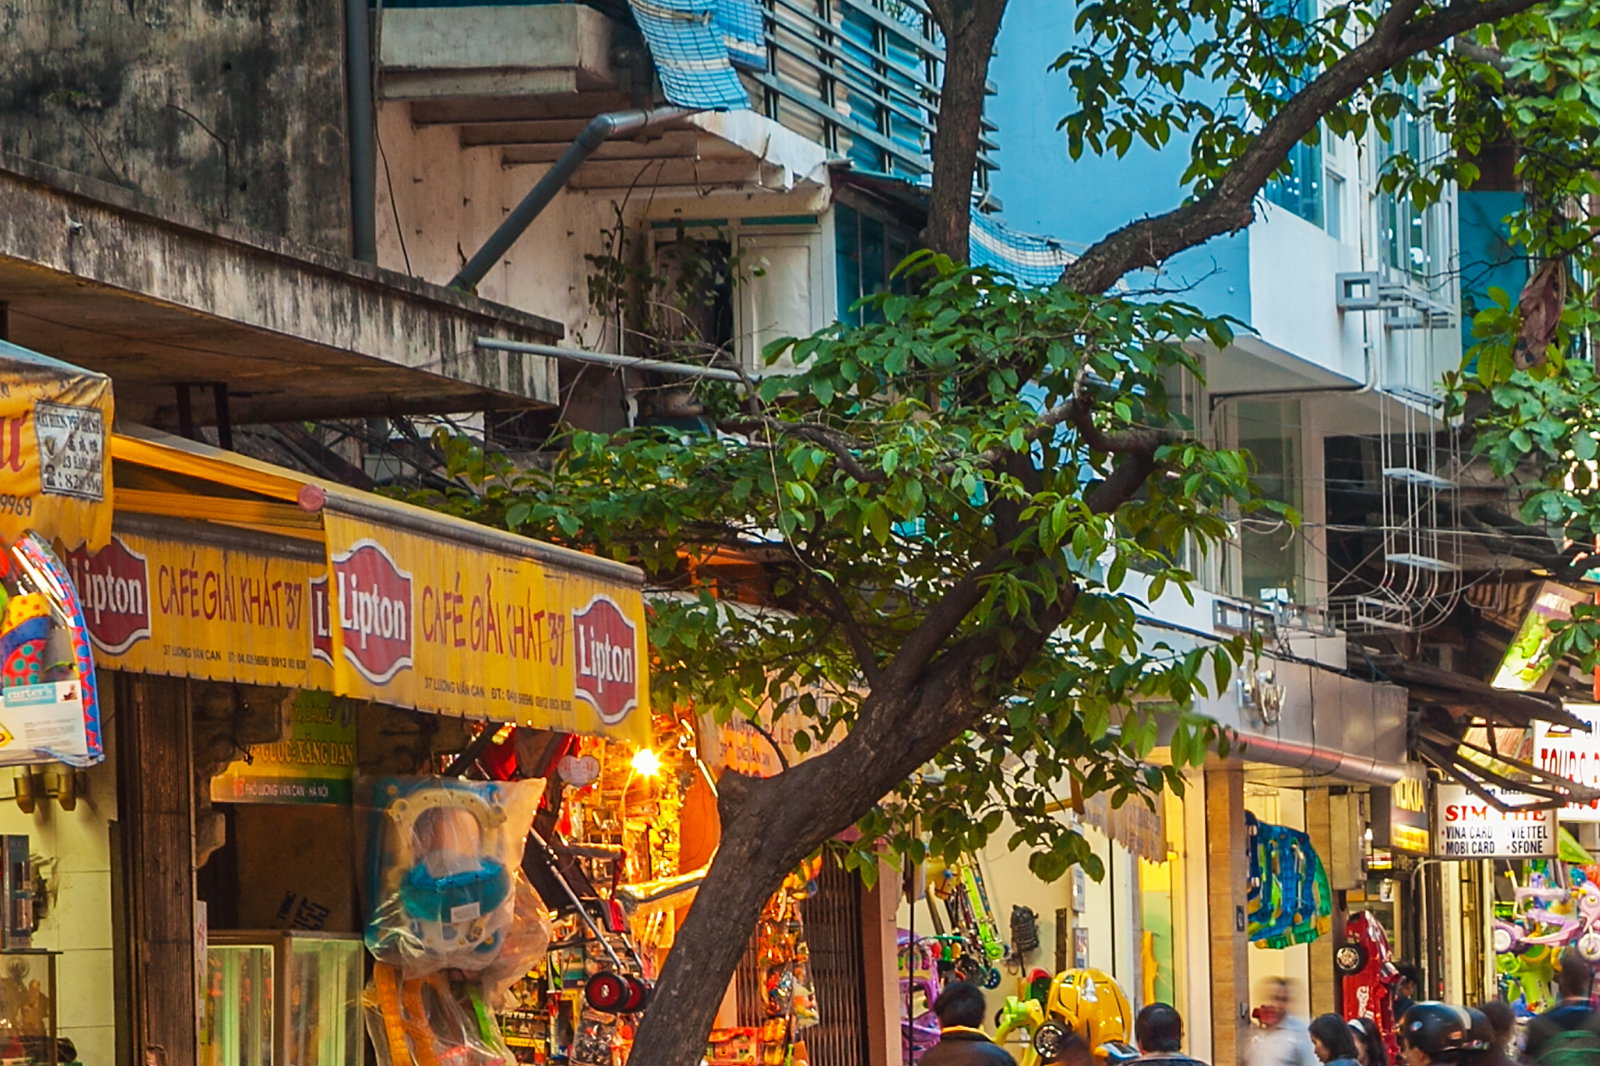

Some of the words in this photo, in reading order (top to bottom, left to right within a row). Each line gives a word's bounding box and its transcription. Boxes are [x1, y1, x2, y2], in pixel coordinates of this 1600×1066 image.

[71, 556, 144, 625] Lipton
[158, 551, 199, 618] CAFÉ
[241, 562, 281, 627] KHÁT
[284, 581, 303, 630] 37
[337, 571, 406, 650] Lipton
[422, 571, 466, 648] CAFÉ
[548, 612, 565, 667] 37
[206, 649, 222, 661] CAN
[578, 624, 634, 693] Lipton
[1445, 805, 1487, 822] SIM
[1445, 826, 1467, 840] VINA
[1470, 826, 1493, 839] CARD
[1511, 825, 1549, 840] VIETTEL
[1445, 841, 1470, 855] MOBI
[1471, 841, 1495, 855] CARD
[1511, 840, 1544, 854] SFONE
